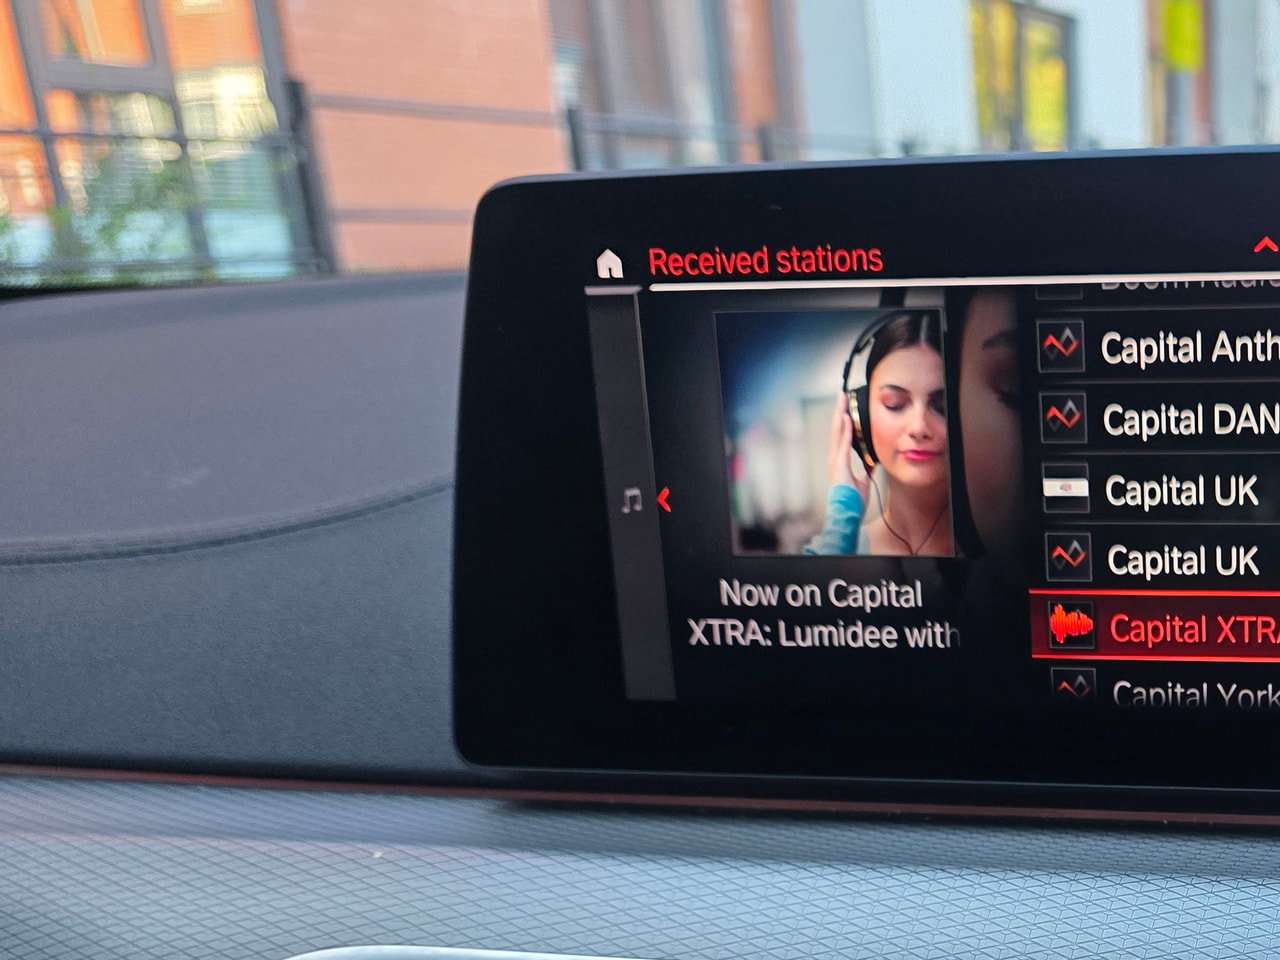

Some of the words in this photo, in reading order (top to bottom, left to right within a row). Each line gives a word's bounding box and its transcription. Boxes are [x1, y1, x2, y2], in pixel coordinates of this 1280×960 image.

[648, 245, 770, 277] Received
[775, 244, 884, 274] stations
[1101, 330, 1202, 371] Capital
[1103, 402, 1203, 442] Capital
[1105, 474, 1205, 513] Capital
[1214, 474, 1259, 507] UK
[1108, 544, 1206, 582] Capital
[1215, 545, 1260, 576] UK
[719, 578, 780, 607] Now
[785, 584, 822, 608] on
[828, 578, 923, 614] Capital
[687, 618, 773, 647] XTRA:
[778, 619, 899, 649] Lumidee
[903, 620, 960, 649] with
[1110, 613, 1207, 649] Capital
